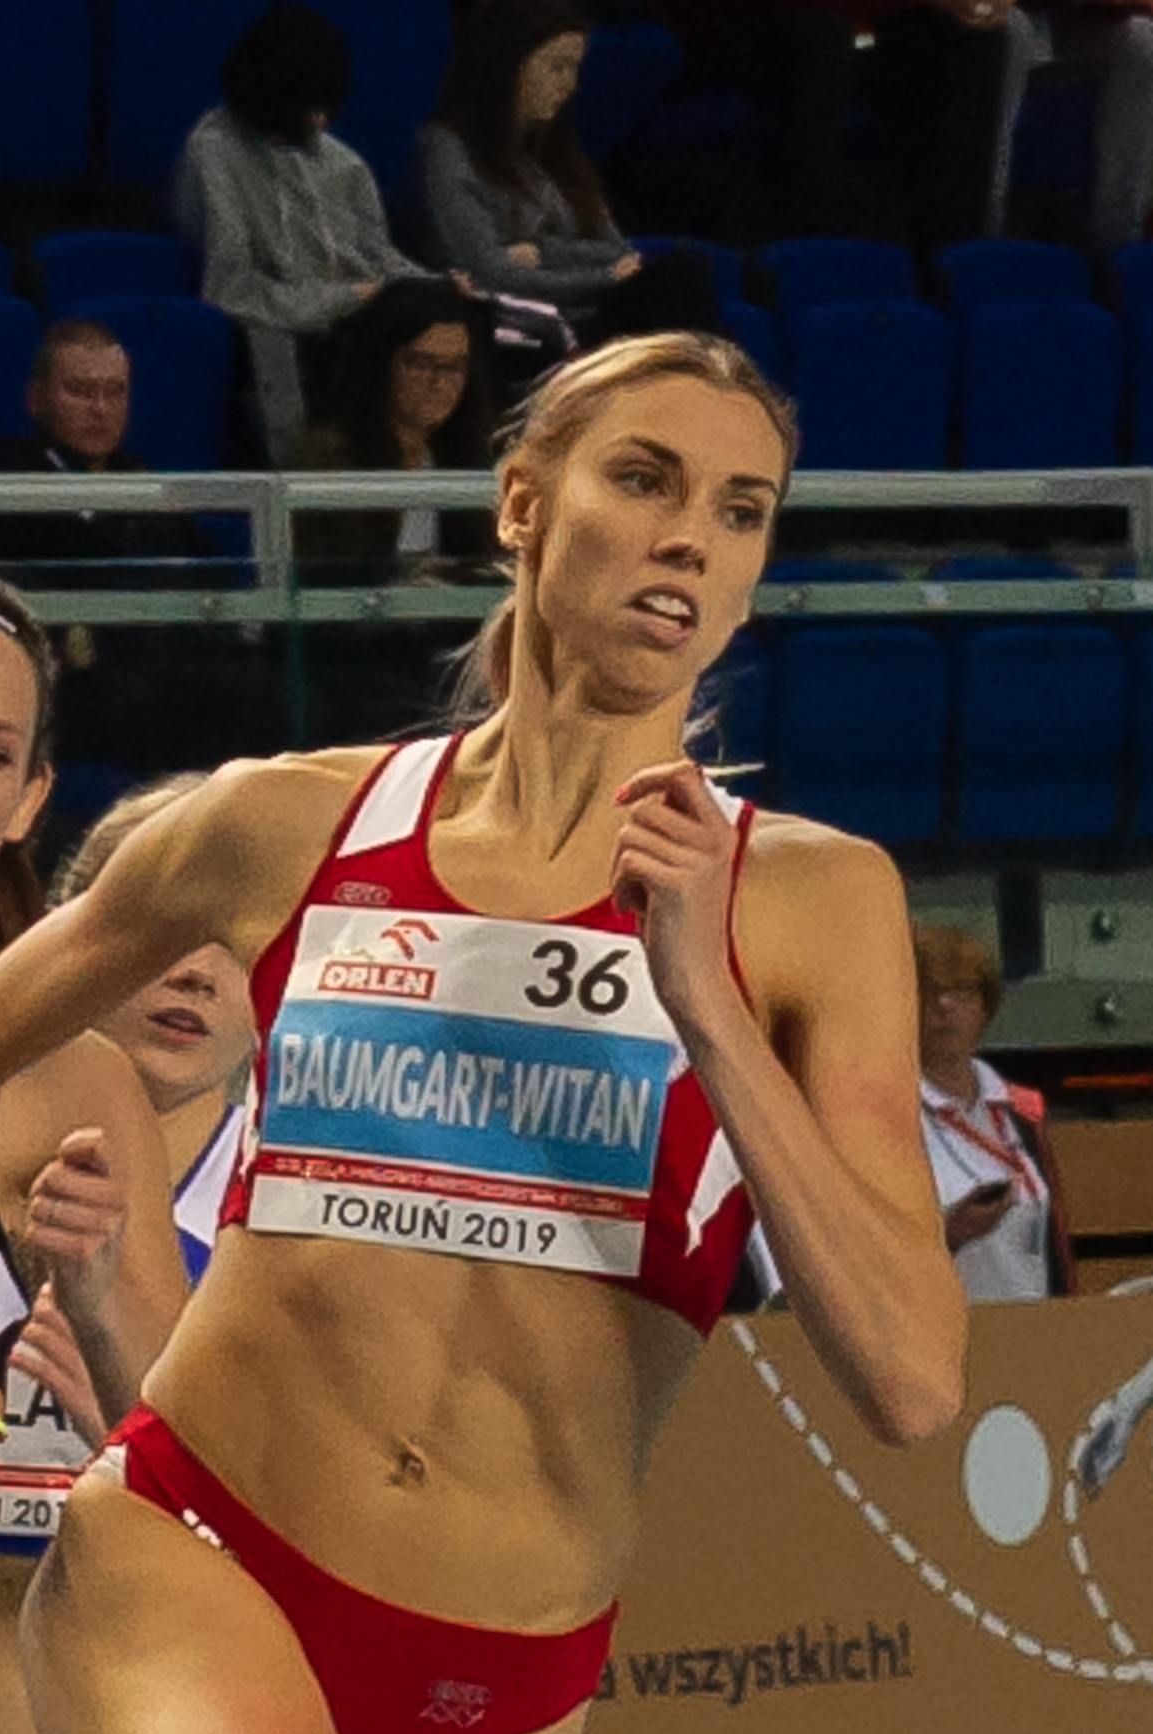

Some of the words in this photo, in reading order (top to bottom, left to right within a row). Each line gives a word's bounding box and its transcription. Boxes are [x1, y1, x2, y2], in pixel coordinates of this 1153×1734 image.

[322, 963, 431, 997] ORLEN
[525, 939, 631, 1015] 36
[277, 1032, 651, 1152] BAUMGART-WITAN
[320, 1193, 450, 1242] TORUŃ
[460, 1212, 558, 1254] 2019
[627, 1620, 913, 1707] wszystkich!
